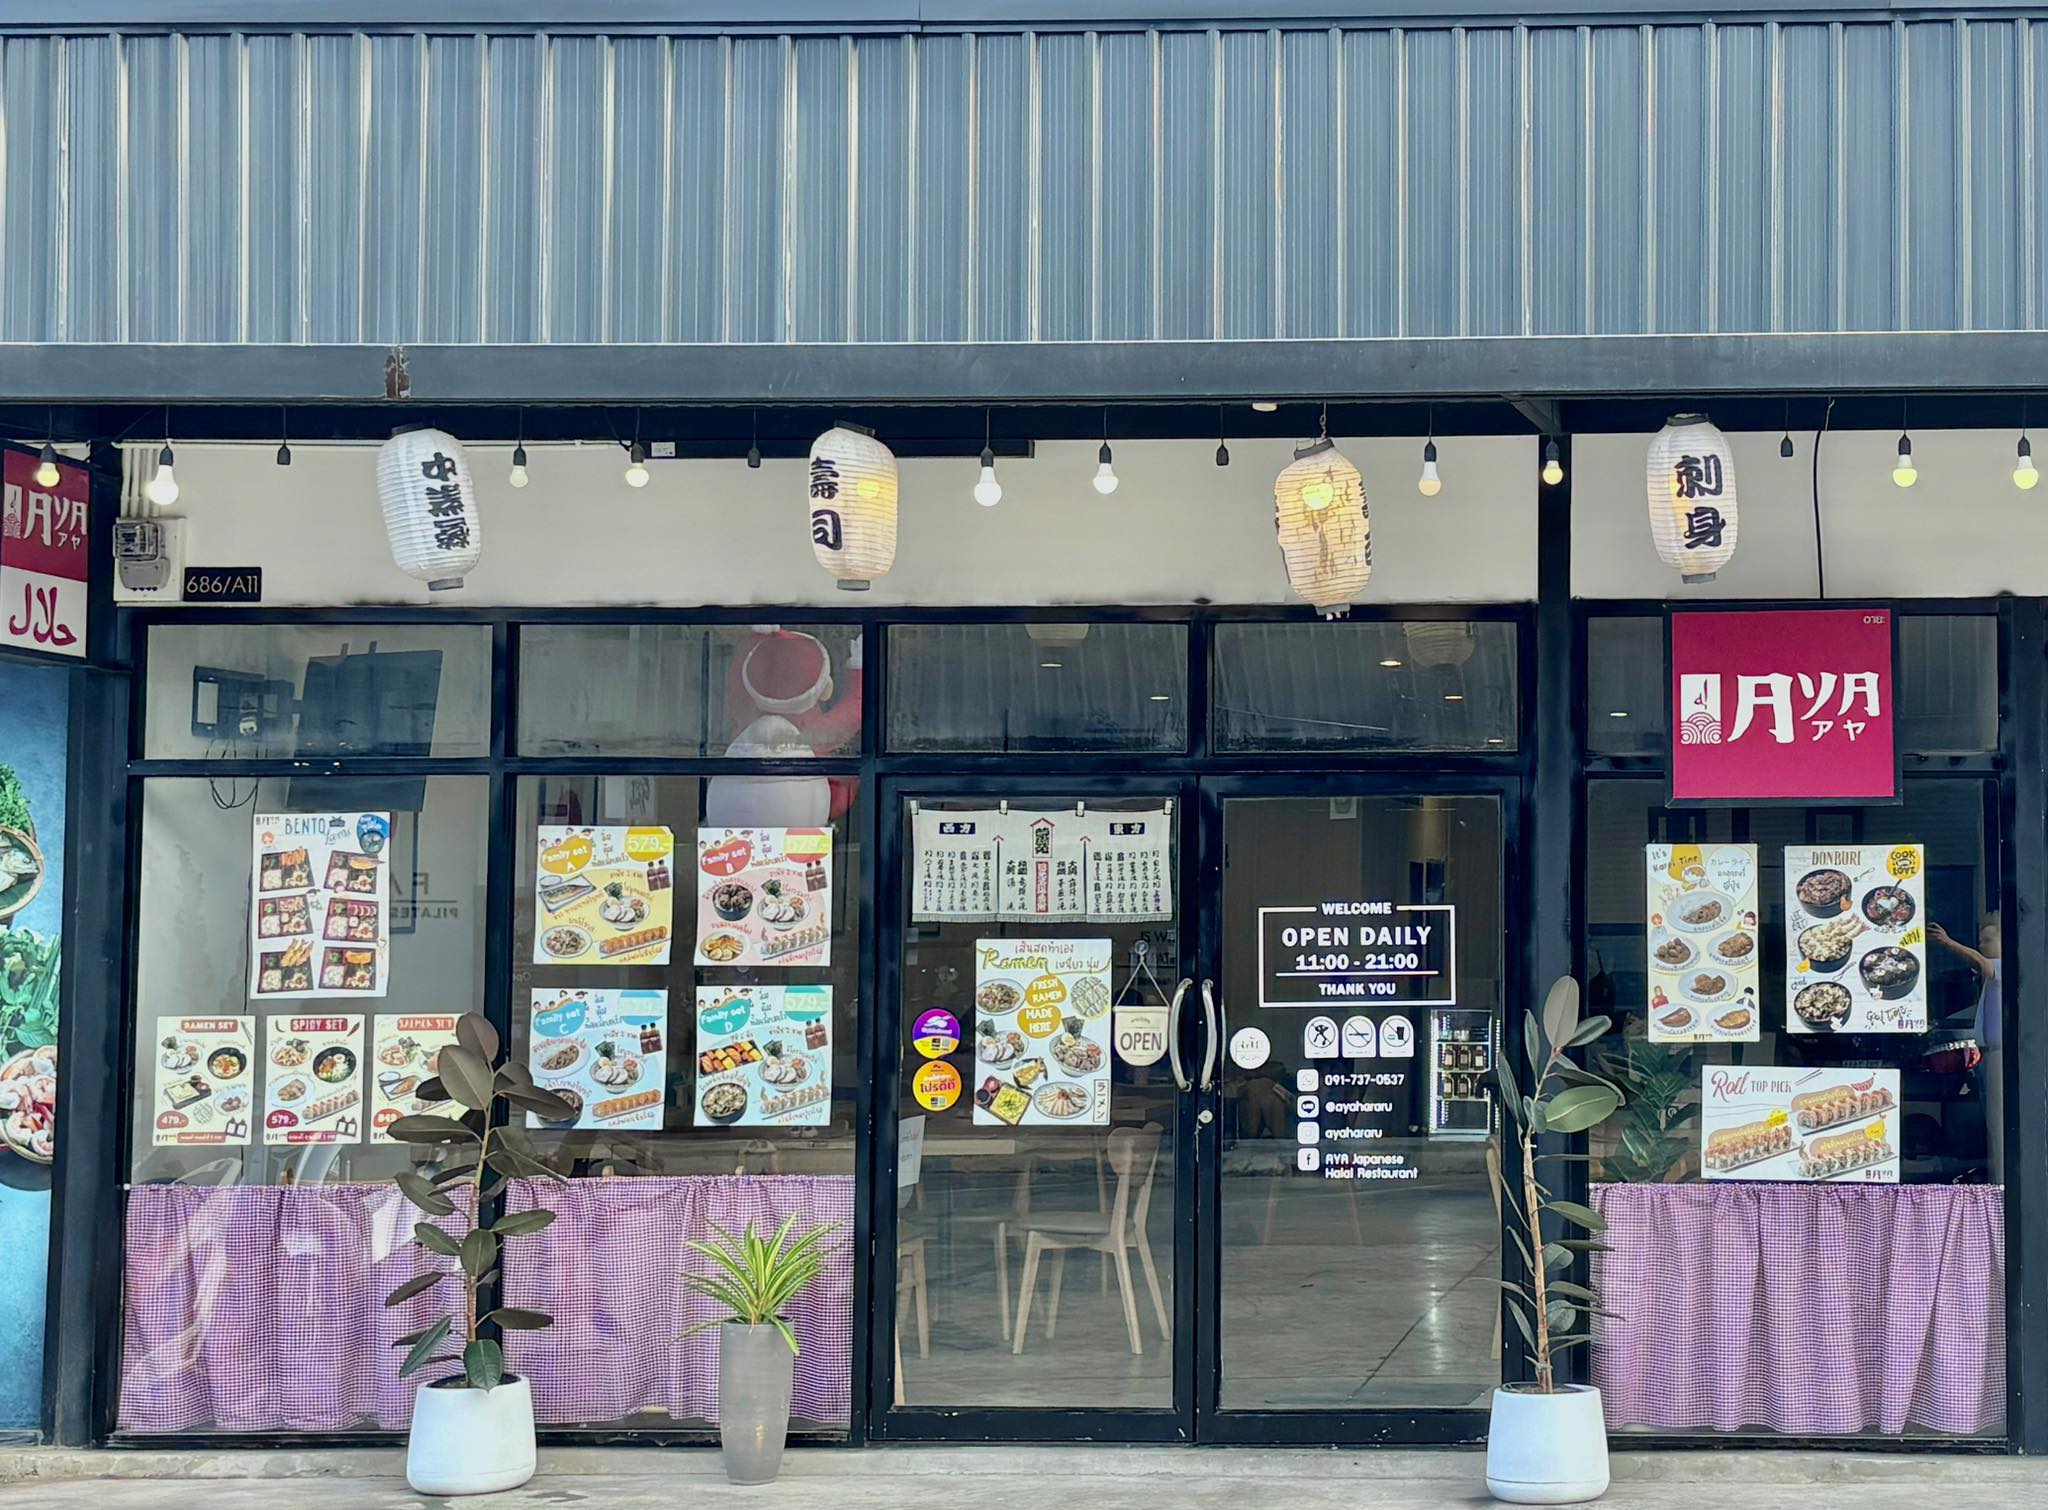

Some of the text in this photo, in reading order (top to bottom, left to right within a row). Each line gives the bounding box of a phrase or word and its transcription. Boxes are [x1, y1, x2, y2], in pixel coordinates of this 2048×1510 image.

[1674, 455, 1726, 549] 刺身
[186, 575, 258, 593] 686/A11
[9, 583, 77, 646] حلال
[1811, 719, 1865, 741] アヤ
[285, 817, 326, 834] BENTO
[1811, 850, 1862, 865] DONBURI
[1890, 850, 1916, 859] COOK
[567, 861, 576, 872] A
[1321, 902, 1392, 915] WELCOME
[1281, 926, 1432, 947] OPEN DAILY
[1295, 953, 1349, 970] 11:00
[1364, 953, 1419, 969] 21:00
[1032, 990, 1062, 1003] RAMEN
[1318, 983, 1396, 996] THANK YOU
[1025, 1008, 1054, 1019] MADE
[219, 1020, 235, 1030] SET
[325, 1019, 344, 1030] SET
[1120, 1032, 1162, 1051] OPEN
[1324, 1074, 1405, 1086] 091-737-0537
[1710, 1071, 1792, 1103] Roll TOP PICK
[1096, 1081, 1107, 1119] ラーメン
[1325, 1101, 1393, 1114] @ayahararu
[1325, 1126, 1382, 1140] ayahararu
[1325, 1153, 1404, 1167] AYA Japanese
[1325, 1167, 1418, 1179] Halal Restaurant
